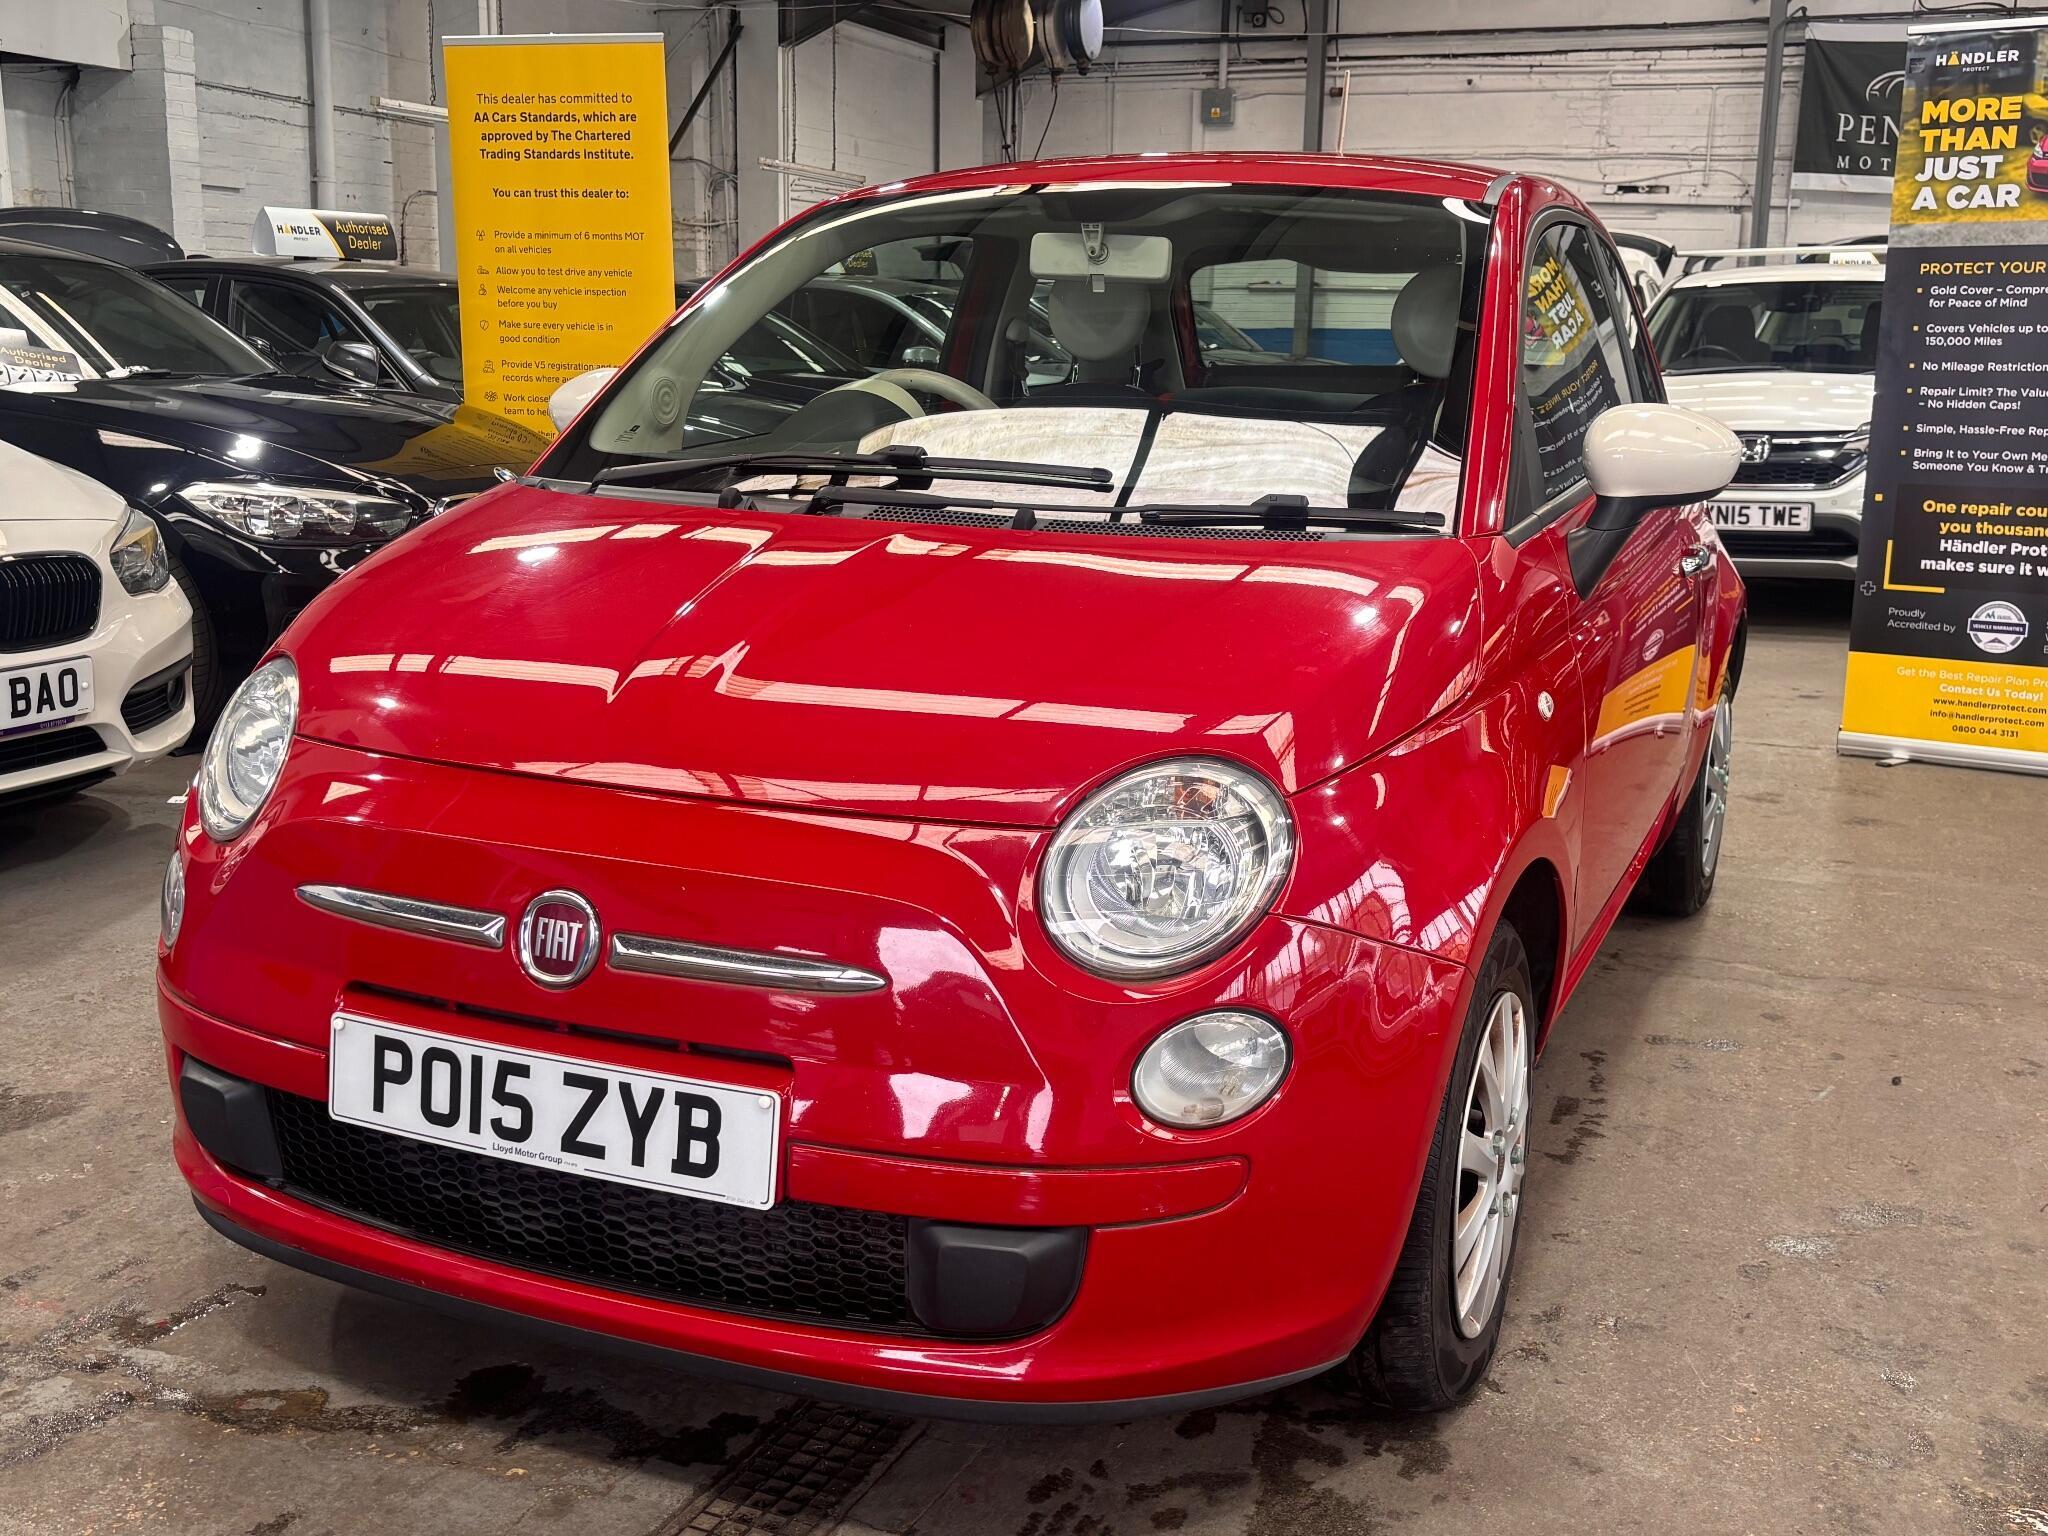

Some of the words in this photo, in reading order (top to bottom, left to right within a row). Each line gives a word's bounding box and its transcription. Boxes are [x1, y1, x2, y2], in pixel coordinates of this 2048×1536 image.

[476, 93, 498, 104] This
[502, 93, 535, 104] dealer
[538, 93, 556, 104] has
[560, 92, 618, 104] committed
[621, 92, 632, 103] to
[1922, 96, 2022, 124] MORE
[474, 112, 489, 122] AA
[492, 112, 516, 122] Cars
[520, 112, 580, 123] Standards,
[583, 111, 616, 122] which
[619, 113, 636, 122] are
[481, 130, 532, 142] approved
[536, 130, 548, 142] by
[551, 130, 571, 140] The
[575, 130, 630, 140] Chartered
[1919, 125, 2018, 152] THAN
[480, 149, 520, 161] Trading
[524, 149, 580, 159] Standards
[584, 149, 633, 159] Institute.
[1914, 155, 2003, 182] JUST
[493, 188, 510, 197] You
[514, 189, 531, 197] can
[534, 188, 557, 198] trust
[560, 188, 579, 198] this
[582, 189, 613, 198] dealer
[616, 189, 629, 198] to:
[1911, 187, 1937, 210] A
[1947, 184, 2020, 209] CAR
[336, 220, 388, 235] Authorised
[494, 230, 525, 239] Provide
[535, 231, 571, 239] minimum
[574, 232, 582, 240] of
[592, 232, 622, 240] months
[625, 232, 644, 240] MOT
[349, 236, 381, 250] Dealer
[507, 245, 516, 253] all
[519, 246, 551, 254] vehicles
[496, 266, 518, 275] Allow
[520, 268, 535, 276] you
[565, 268, 585, 276] drive
[588, 269, 601, 278] any
[604, 269, 632, 277] vehicle
[1920, 262, 1995, 274] PROTECT
[2000, 261, 2046, 273] YOUR
[497, 285, 535, 294] Welcome
[538, 288, 551, 296] any
[554, 287, 582, 295] vehicle
[584, 288, 626, 296] inspection
[1930, 286, 1957, 295] Gold
[1960, 285, 1993, 294] Cover
[497, 299, 524, 308] before
[527, 301, 540, 309] you
[543, 301, 557, 310] buy
[1929, 298, 1945, 307] for
[1948, 298, 1981, 307] Peace
[1985, 298, 1998, 307] of
[2000, 298, 2027, 307] Mind
[499, 320, 521, 328] Make
[543, 322, 564, 331] every
[566, 322, 595, 330] vehicle
[1926, 324, 1964, 333] Covers
[1968, 324, 2015, 333] Vehicles
[2019, 325, 2033, 334] up
[2037, 324, 2048, 333] to
[500, 335, 520, 343] good
[523, 335, 560, 343] condition
[1925, 337, 1970, 347] 150,000
[1974, 337, 2002, 346] Miles
[0, 347, 66, 363] Authorised
[14, 356, 56, 368] Dealer
[501, 360, 532, 368] Provide
[534, 361, 545, 369] V5
[548, 363, 593, 371] registration
[1922, 362, 1938, 370] No
[1942, 362, 1984, 372] Mileage
[502, 374, 533, 382] records
[503, 393, 525, 402] Work
[1920, 387, 1956, 396] Repair
[1959, 387, 1993, 396] Limit?
[1997, 387, 2017, 397] The
[504, 407, 524, 415] team
[1928, 400, 1943, 408] No
[1947, 400, 1985, 409] Hidden
[1990, 400, 2020, 411] Caps!
[1916, 424, 1956, 434] Simple,
[1960, 425, 2025, 435] Hassle-Free
[1914, 448, 1942, 459] Bring
[1957, 450, 1968, 459] to
[1972, 450, 1999, 459] Your
[2002, 451, 2027, 460] Own
[1912, 461, 1963, 471] Someone
[1967, 462, 1988, 471] You
[1992, 463, 2024, 473] Know
[2027, 464, 2034, 473] &
[1923, 500, 1956, 513] One
[1961, 503, 2012, 517] repair
[1710, 506, 1750, 524] N15
[1759, 506, 1801, 525] TWE
[1939, 522, 1971, 534] you
[1940, 539, 2006, 554] Händler
[1920, 558, 1974, 572] makes
[1978, 562, 2015, 574] sure
[2020, 562, 2032, 575] it
[1888, 607, 1926, 619] Proudly
[1887, 619, 1940, 631] Accredited
[1943, 623, 1956, 633] by
[1897, 666, 1916, 676] Get
[1919, 668, 1936, 678] the
[1940, 670, 1963, 680] Best
[1967, 672, 2001, 684] Repair
[2006, 676, 2029, 686] Plan
[9, 668, 78, 718] BAO
[1939, 683, 1984, 695] Contact
[1987, 687, 2000, 697] Us
[2005, 689, 2043, 702] Today!
[1933, 698, 2046, 714] www.handlerprotect.com
[1930, 709, 2044, 727] info@handlerprotect.com
[1952, 725, 1976, 734] 0800
[1979, 727, 1997, 736] 044
[2000, 729, 2018, 738] 3131
[535, 917, 583, 962] FIAT
[372, 1034, 533, 1143] PO15
[561, 1071, 722, 1178] ZYB
[492, 1142, 513, 1154] Lloyd
[515, 1147, 537, 1159] Motor
[539, 1152, 562, 1165] Group
